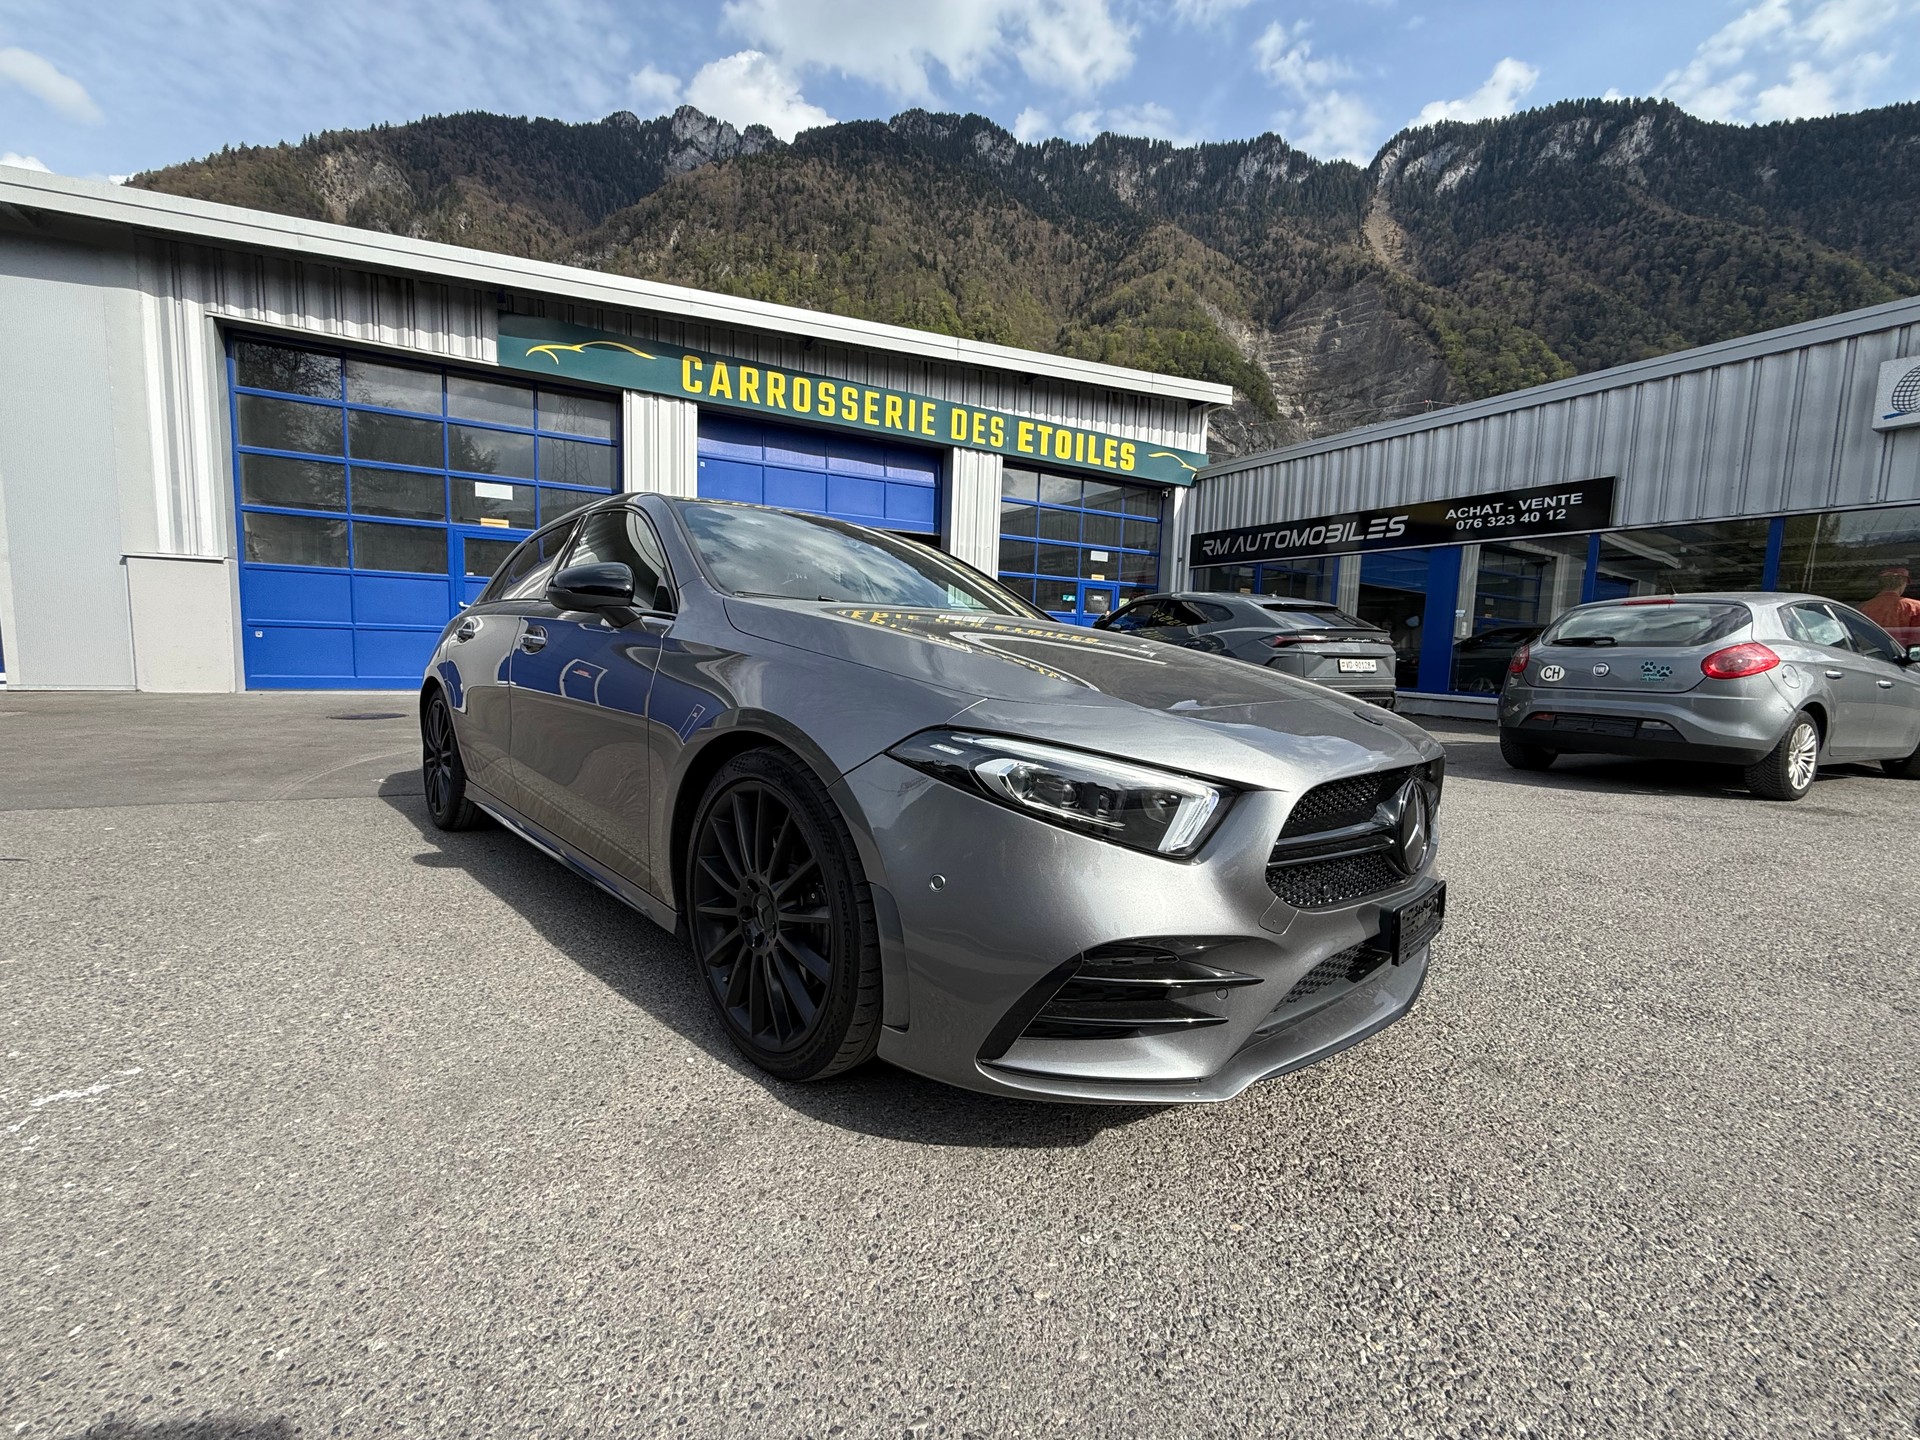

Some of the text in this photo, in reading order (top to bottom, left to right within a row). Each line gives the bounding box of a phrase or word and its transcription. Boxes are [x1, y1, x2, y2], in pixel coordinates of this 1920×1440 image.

[682, 354, 1136, 471] CARROSSERIE DES ETOILES
[1445, 502, 1504, 520] ACHAT
[1518, 492, 1583, 511] VENTE
[1455, 508, 1566, 531] 076 323 40 12
[1202, 515, 1409, 556] RM AUTOMOBILES
[1544, 667, 1561, 679] CH
[838, 879, 852, 990] SportContact
